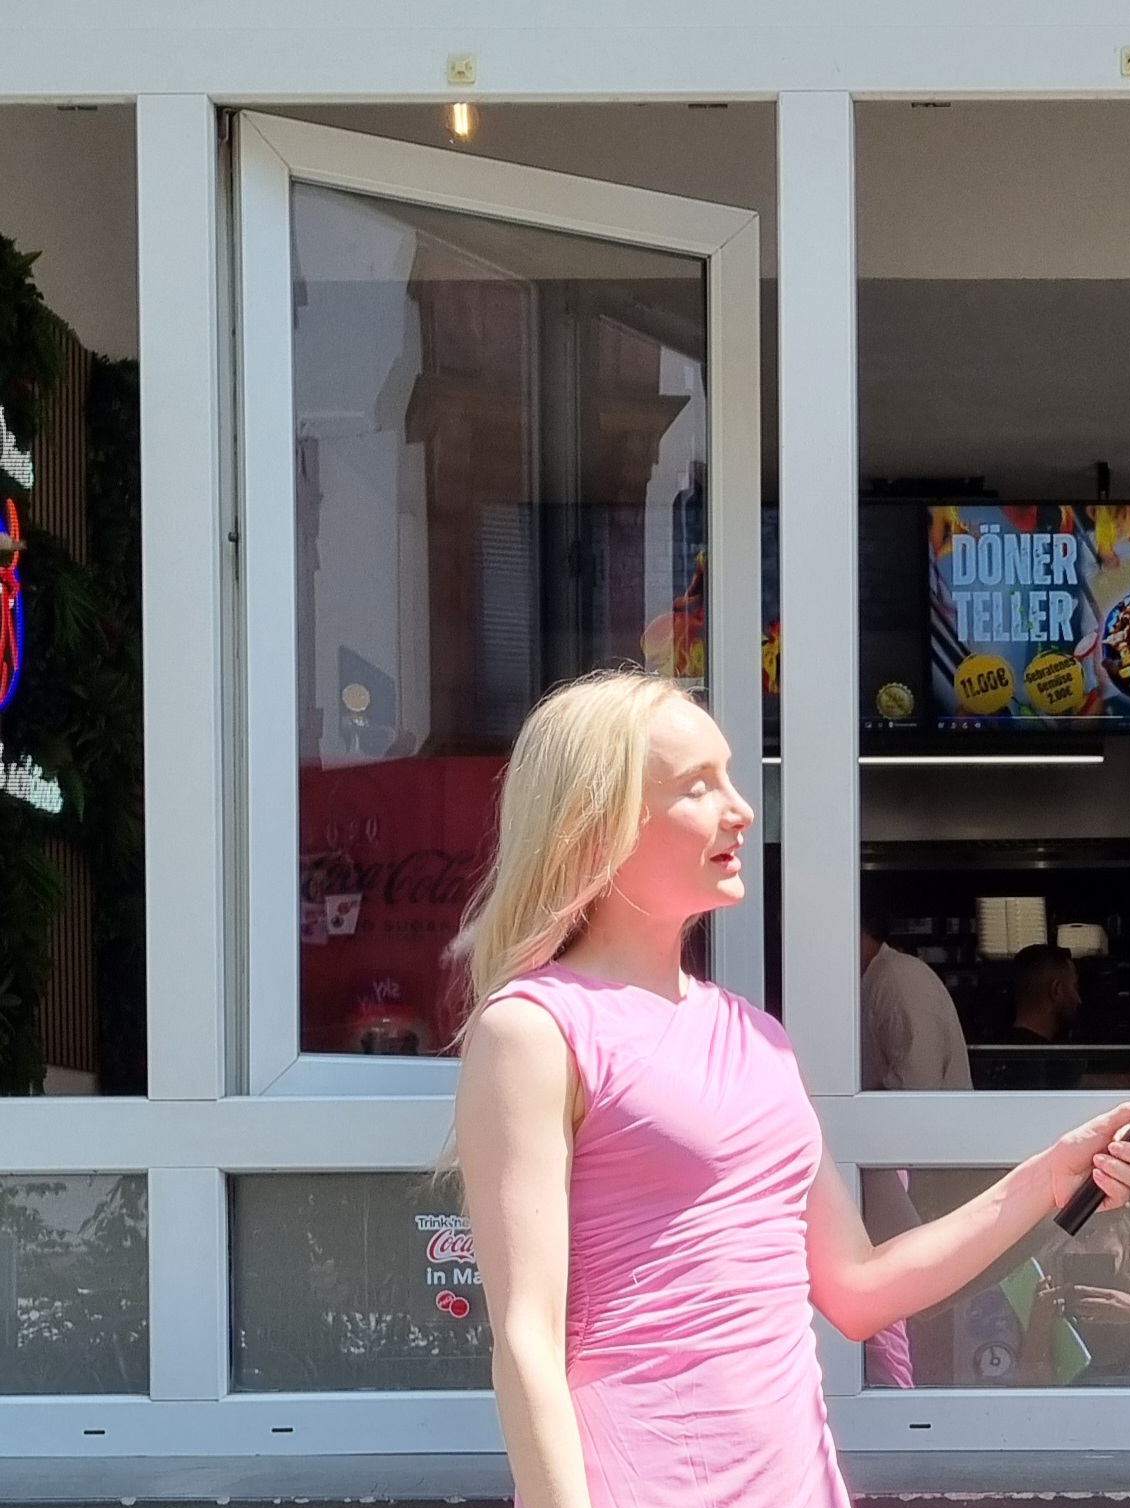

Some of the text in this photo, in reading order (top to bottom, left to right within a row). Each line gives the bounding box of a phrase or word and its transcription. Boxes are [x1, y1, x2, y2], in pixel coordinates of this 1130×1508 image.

[951, 524, 1078, 586] DÖNER
[951, 590, 1076, 643] TELLER
[960, 667, 1009, 699] 11.00€
[426, 1267, 446, 1285] in
